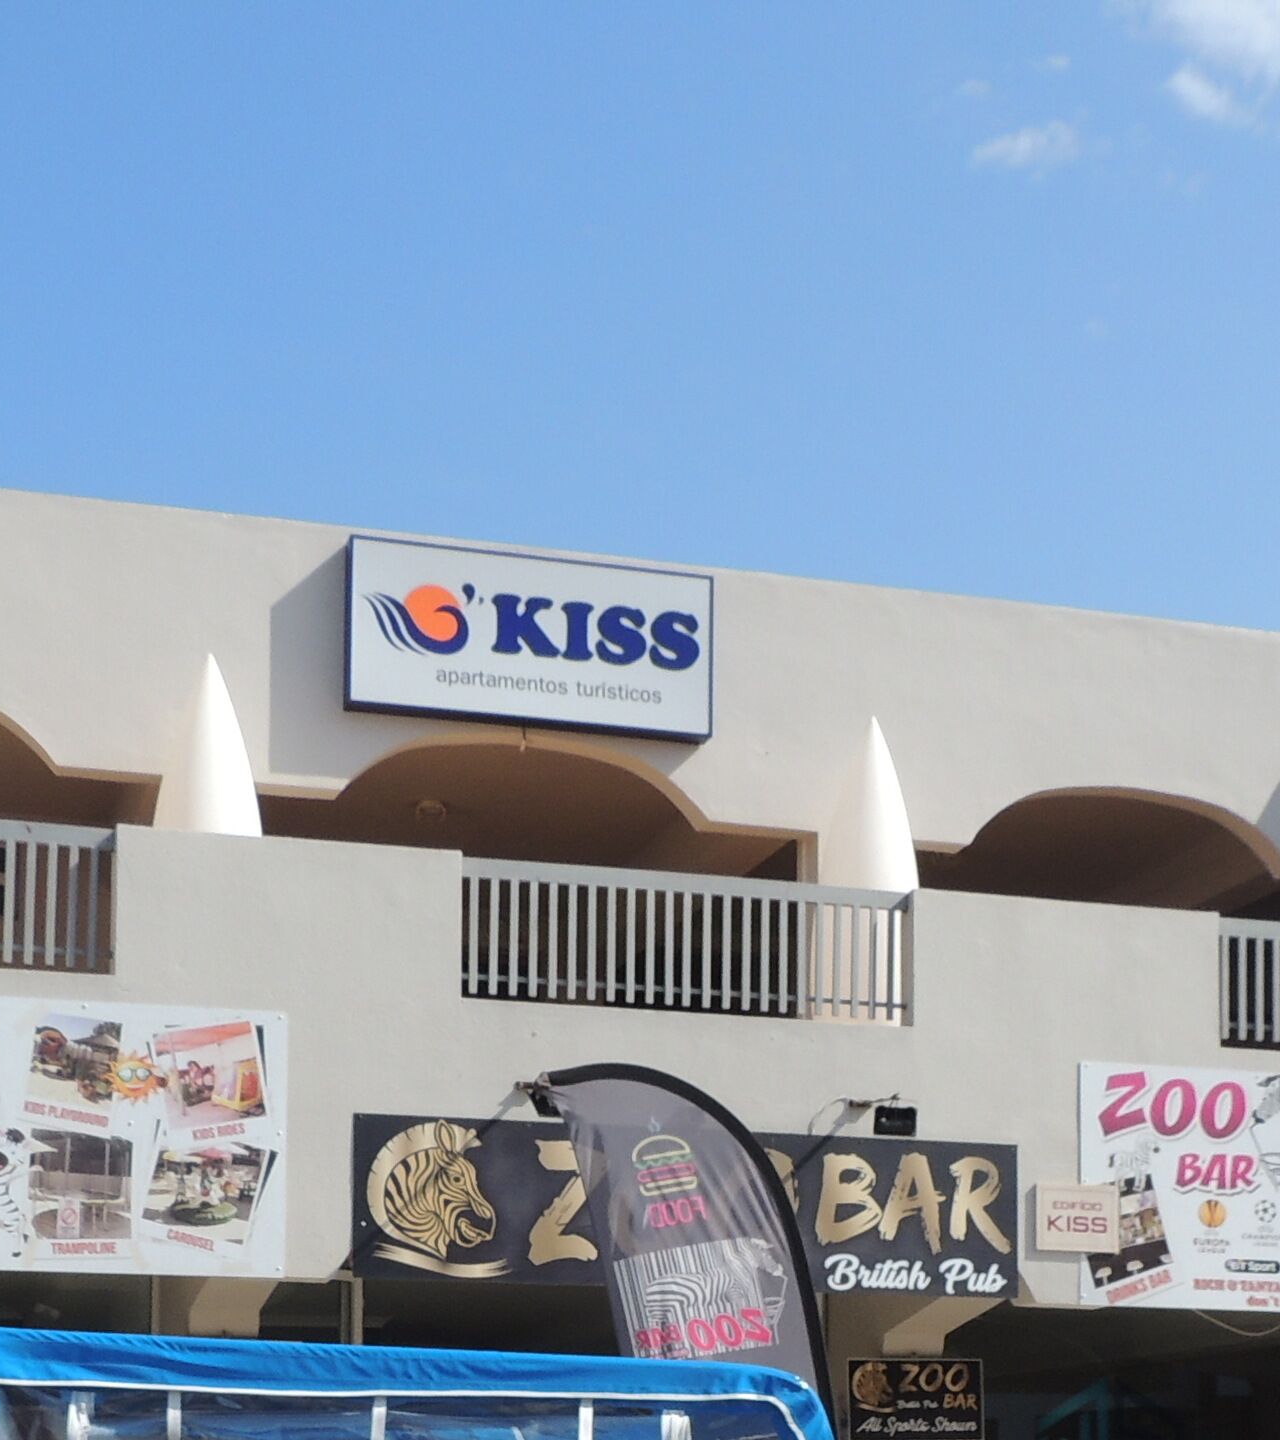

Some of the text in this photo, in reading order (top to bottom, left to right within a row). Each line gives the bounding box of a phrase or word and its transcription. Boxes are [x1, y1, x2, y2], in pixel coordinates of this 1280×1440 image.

[436, 666, 662, 704] apartamentos turísticos
[1097, 1071, 1246, 1139] ZOO
[1175, 1153, 1256, 1190] BAR
[815, 1152, 1012, 1255] BAR
[1047, 1214, 1108, 1234] KISS
[51, 1242, 117, 1256] TRAMPOLINE
[824, 1252, 1008, 1294] British Pub
[1247, 1260, 1276, 1273] Sport
[899, 1363, 969, 1392] ZOO
[943, 1393, 978, 1411] BAR
[856, 1416, 883, 1433] All
[883, 1416, 931, 1437] Sports
